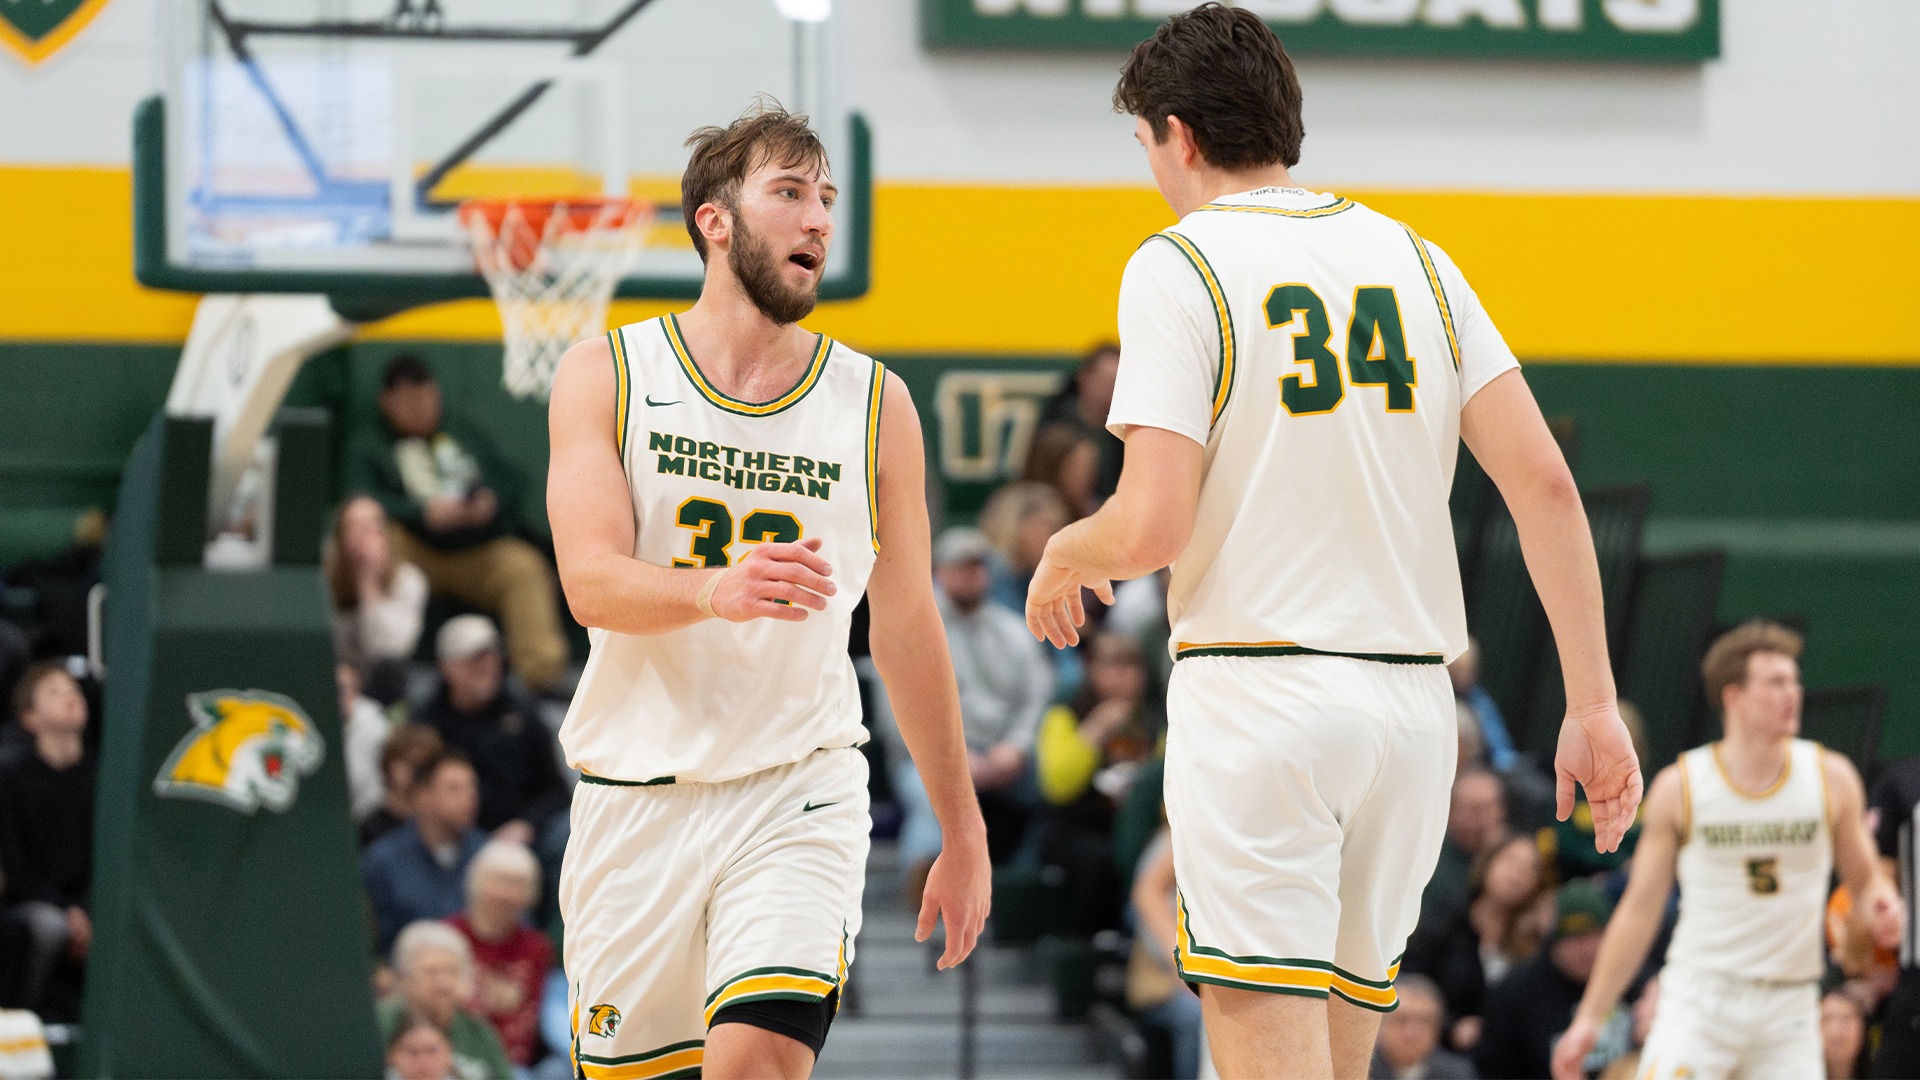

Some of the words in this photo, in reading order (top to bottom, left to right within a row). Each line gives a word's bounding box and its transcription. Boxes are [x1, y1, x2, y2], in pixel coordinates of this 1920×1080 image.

[1250, 187, 1279, 196] NIKE
[1262, 281, 1418, 417] 34
[648, 430, 842, 483] NORTHERN
[656, 453, 832, 501] MICHIGAN
[1744, 855, 1780, 894] 5
